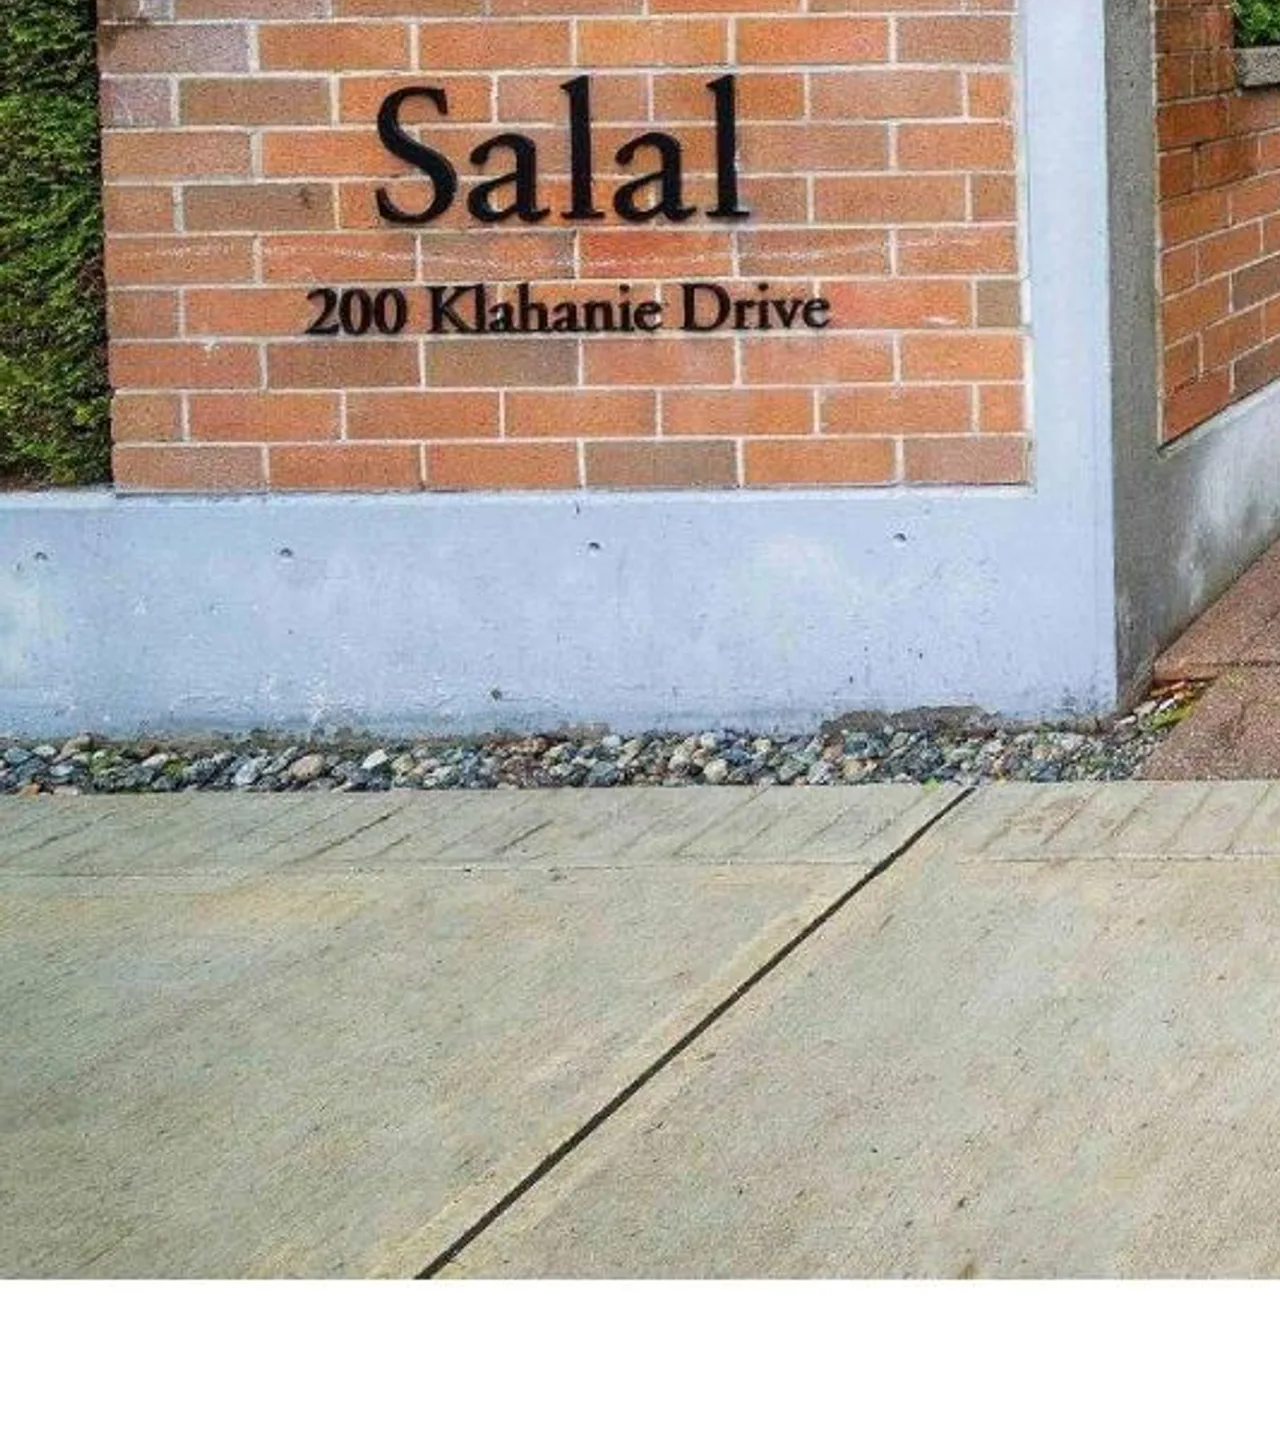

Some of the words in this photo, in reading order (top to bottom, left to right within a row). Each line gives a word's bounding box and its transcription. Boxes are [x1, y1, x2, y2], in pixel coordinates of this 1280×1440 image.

[375, 74, 750, 223] Salal
[305, 288, 408, 336] 200
[429, 284, 663, 335] Klahanie
[682, 283, 830, 333] Drive
